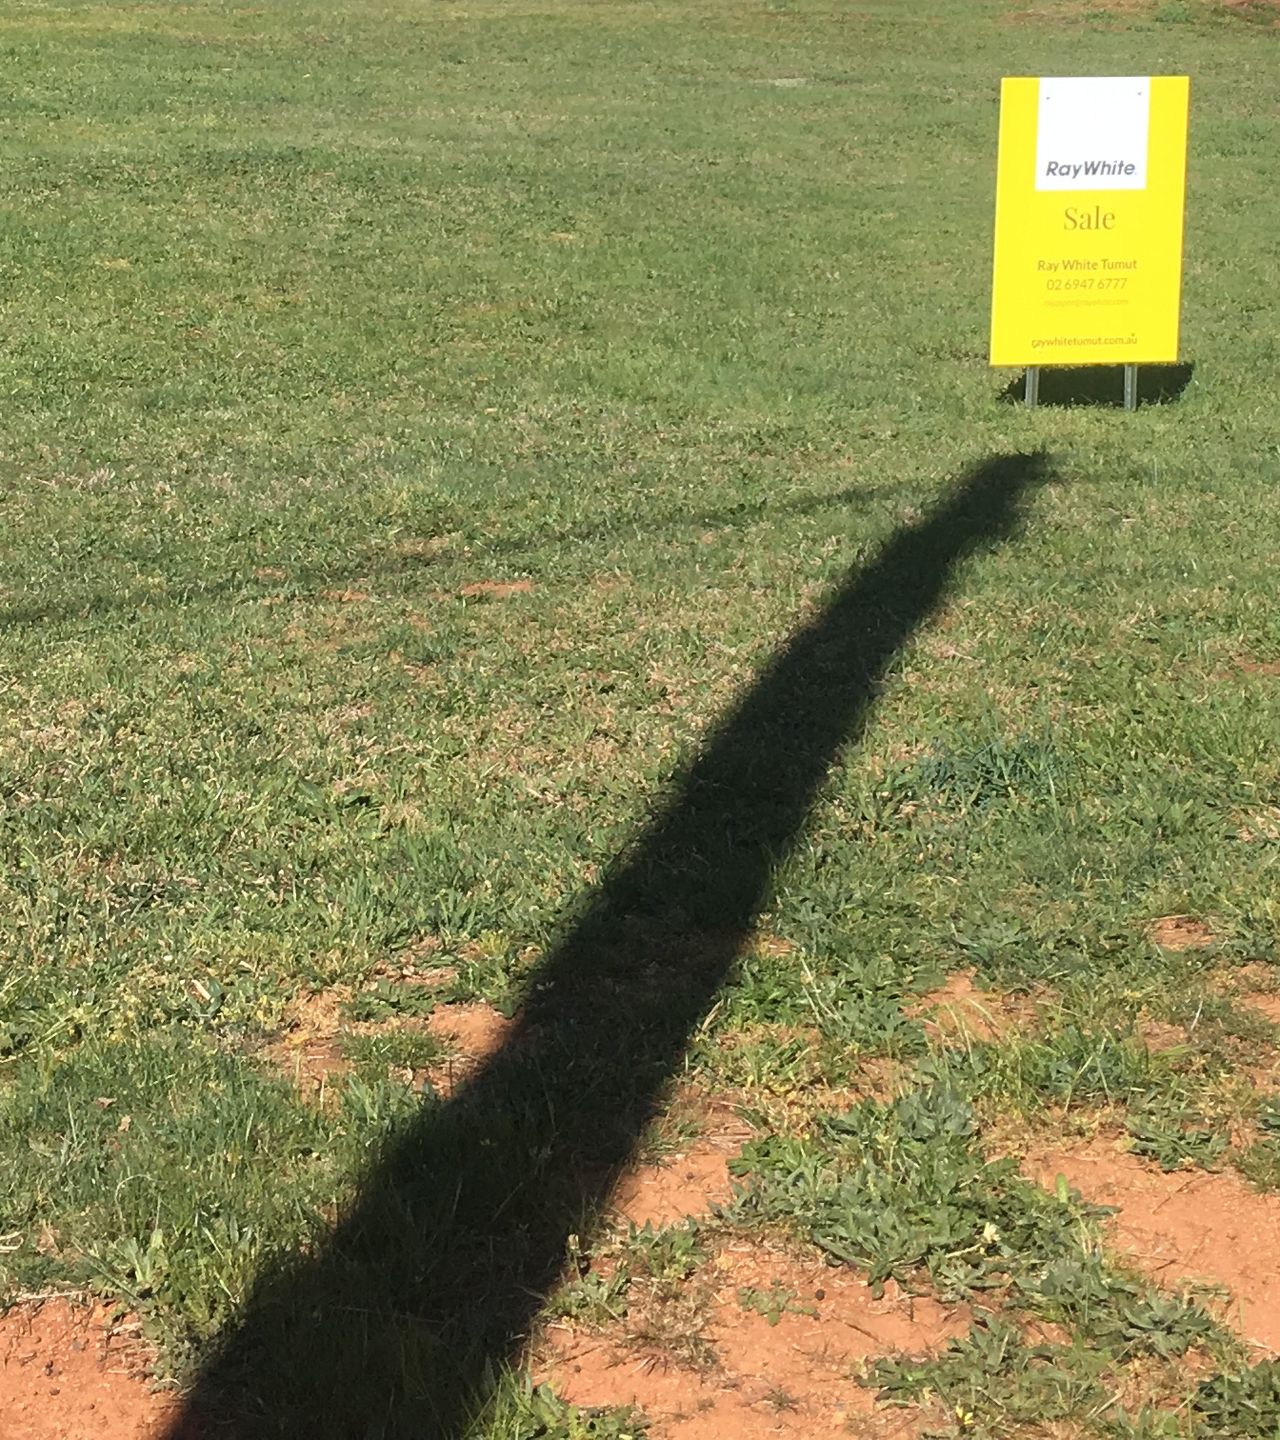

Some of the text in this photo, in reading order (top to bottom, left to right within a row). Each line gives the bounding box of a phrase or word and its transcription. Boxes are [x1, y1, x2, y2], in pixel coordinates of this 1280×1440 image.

[1063, 205, 1116, 231] Sale
[1037, 258, 1138, 272] Ray White Tumut
[1046, 277, 1128, 291] 02 6947 6777
[1031, 336, 1138, 348] raywhitetumut.com.au
